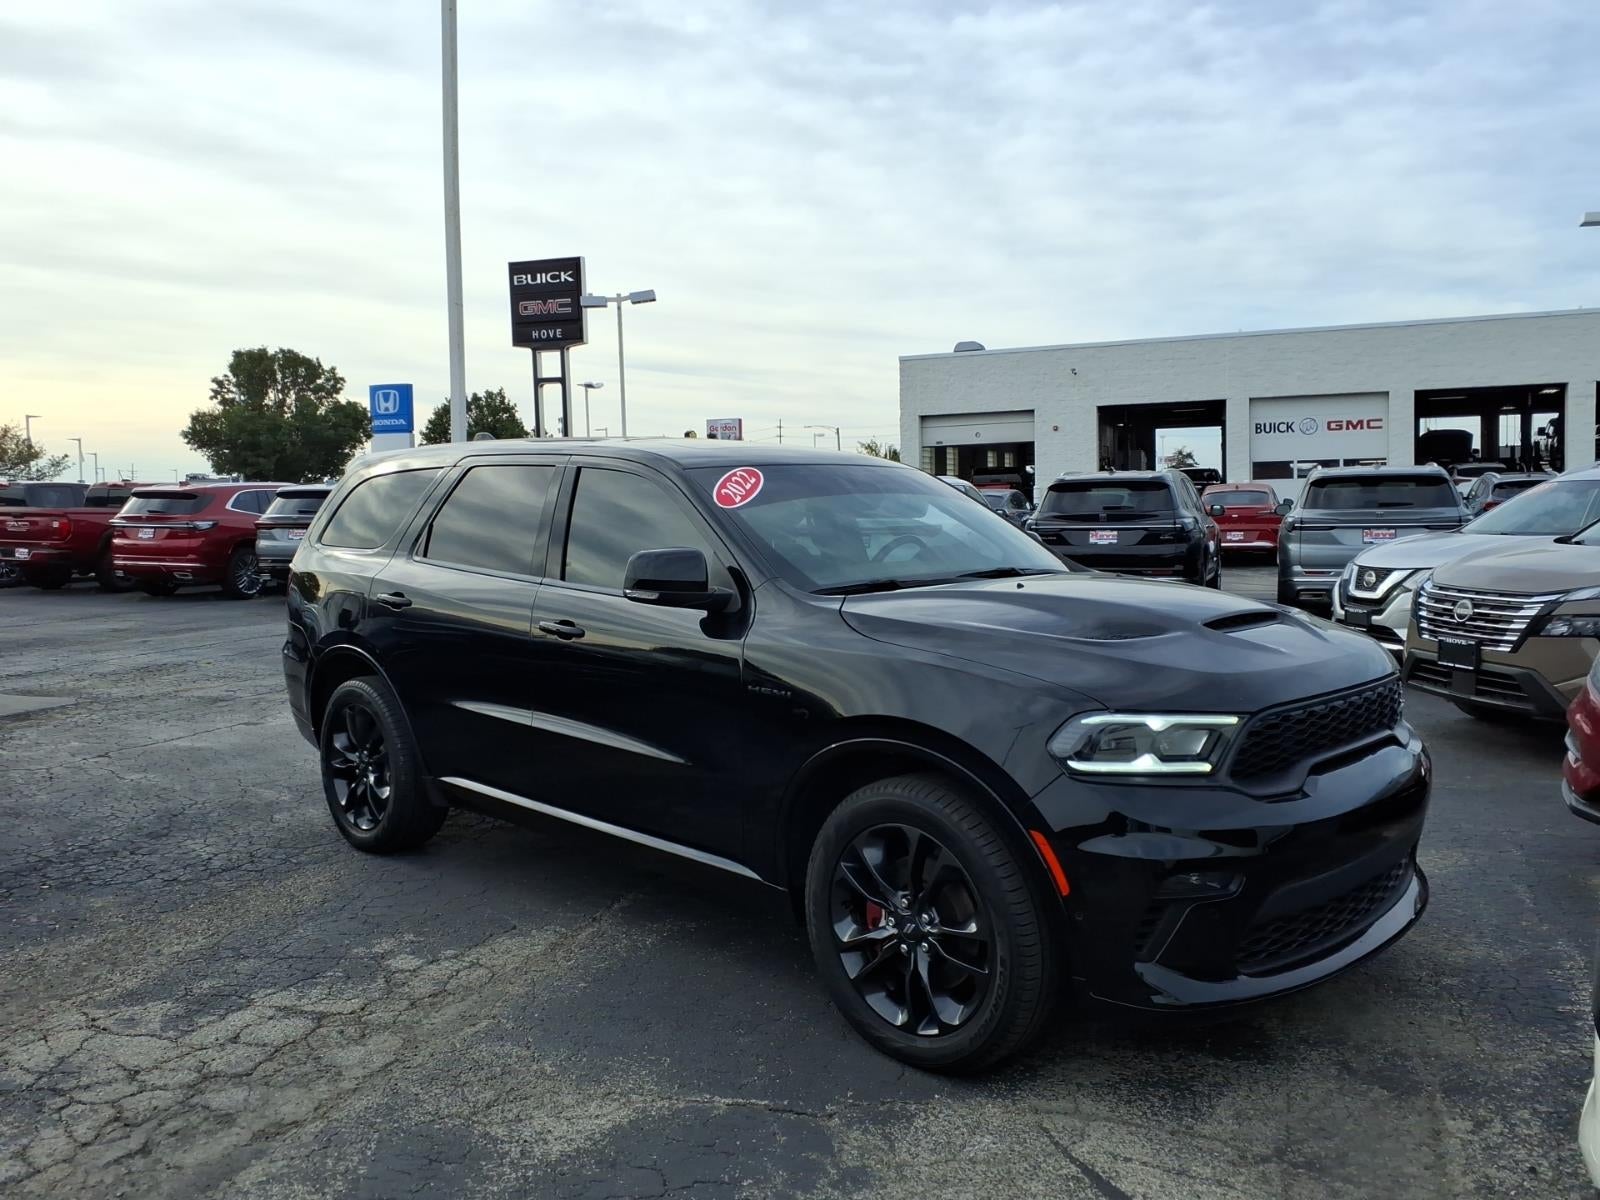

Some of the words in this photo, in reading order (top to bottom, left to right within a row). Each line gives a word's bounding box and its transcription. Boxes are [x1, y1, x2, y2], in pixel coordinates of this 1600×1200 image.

[513, 270, 575, 286] BUICK
[518, 298, 572, 316] GMC
[532, 328, 563, 340] HOVE
[1255, 421, 1295, 434] BUICK
[1326, 418, 1383, 431] GMC
[720, 471, 757, 503] 2022
